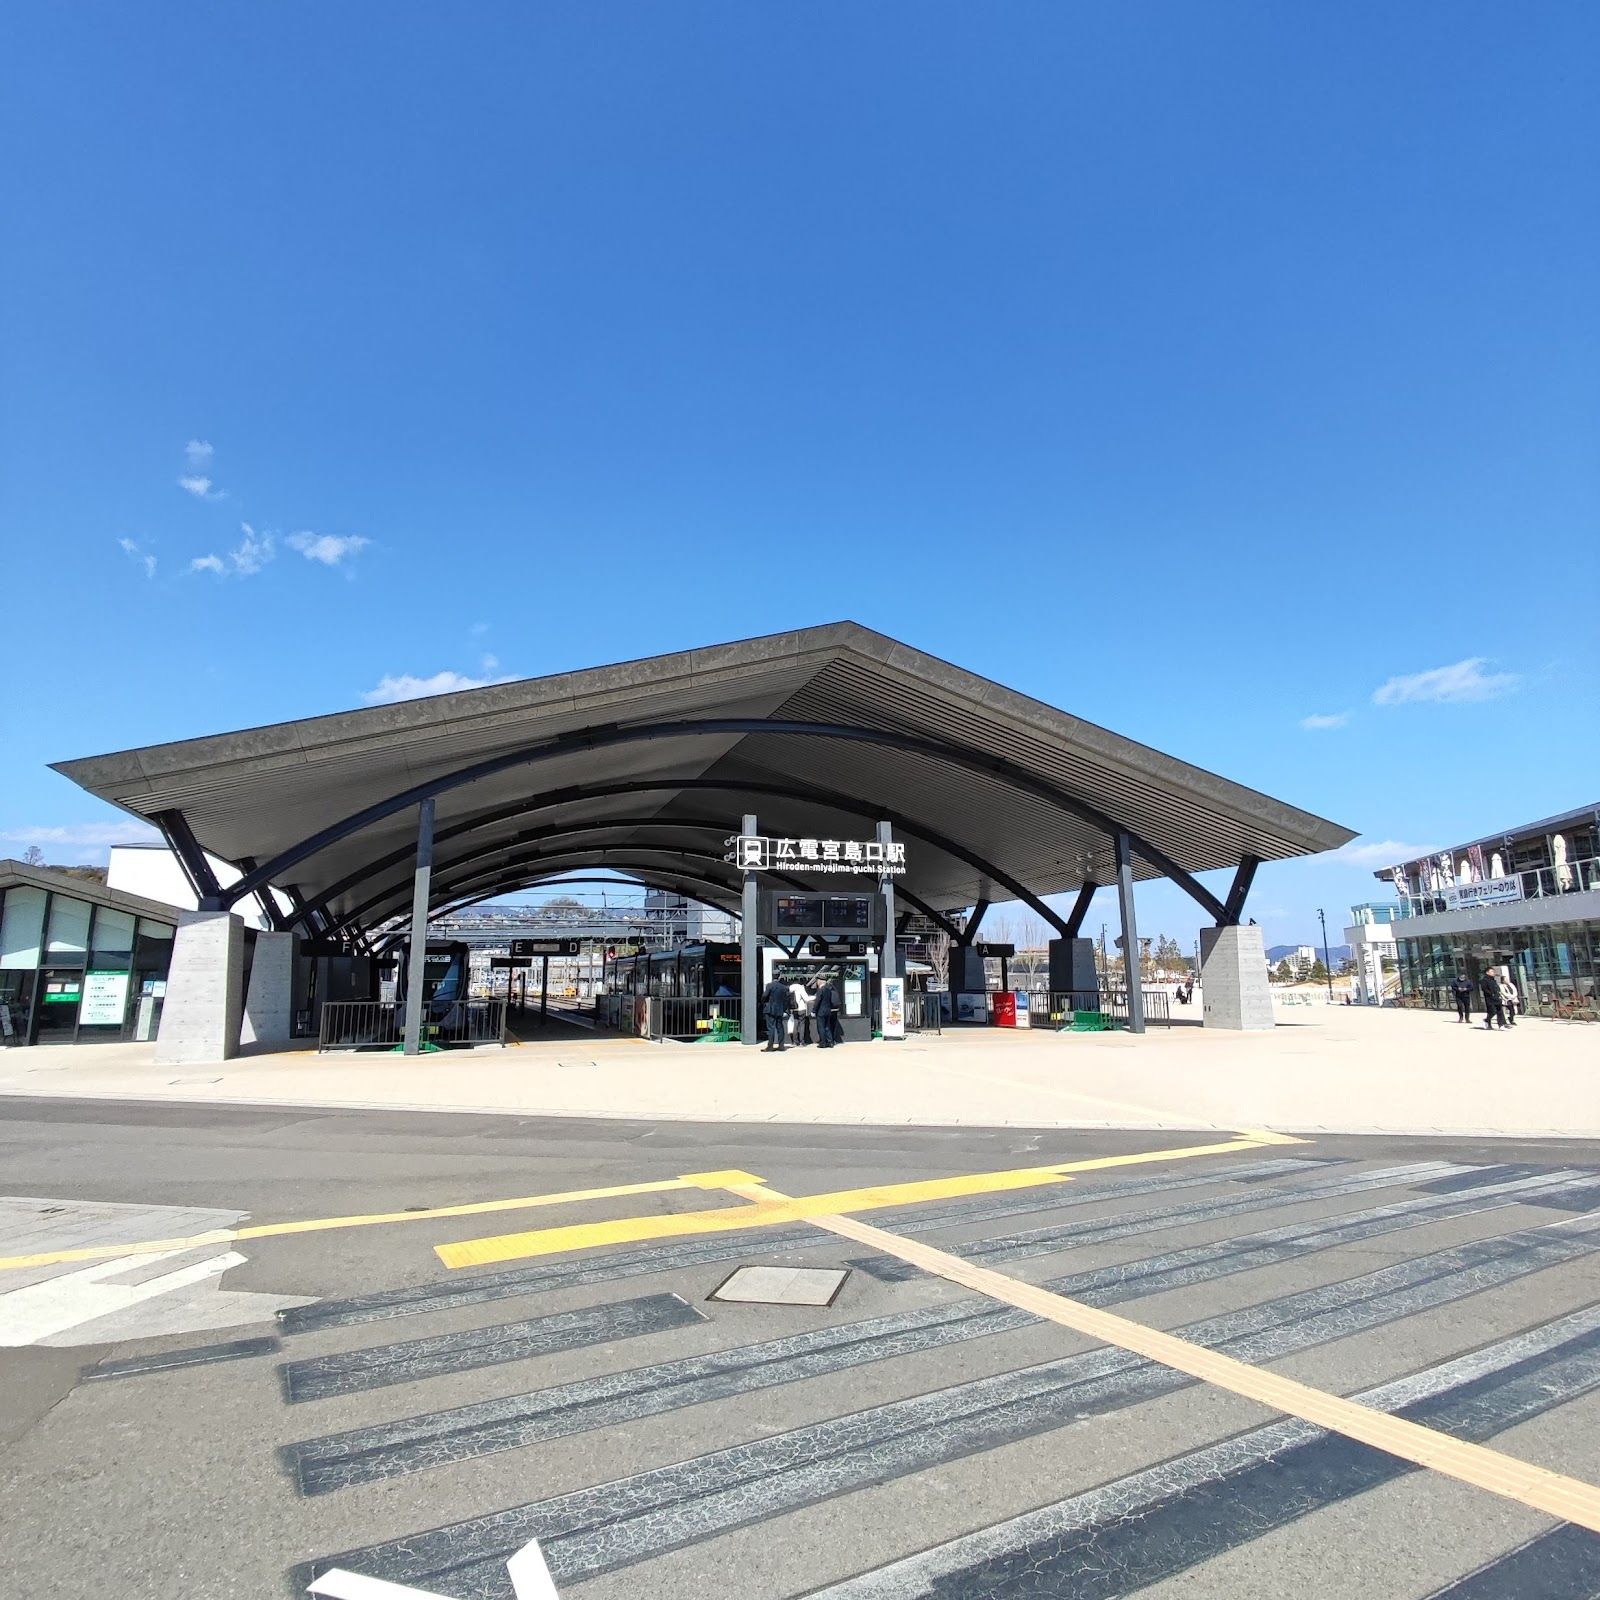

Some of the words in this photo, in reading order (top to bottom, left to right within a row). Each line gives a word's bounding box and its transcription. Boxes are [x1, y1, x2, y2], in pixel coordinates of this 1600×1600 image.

[775, 838, 906, 863] 広電宮島口駅
[776, 861, 875, 874] Hiroden-miyajima-guchi
[877, 865, 906, 875] Station
[342, 941, 351, 953] F
[515, 942, 523, 952] E
[569, 942, 577, 953] D
[813, 943, 820, 953] C
[858, 943, 865, 953] B
[982, 945, 989, 954] A
